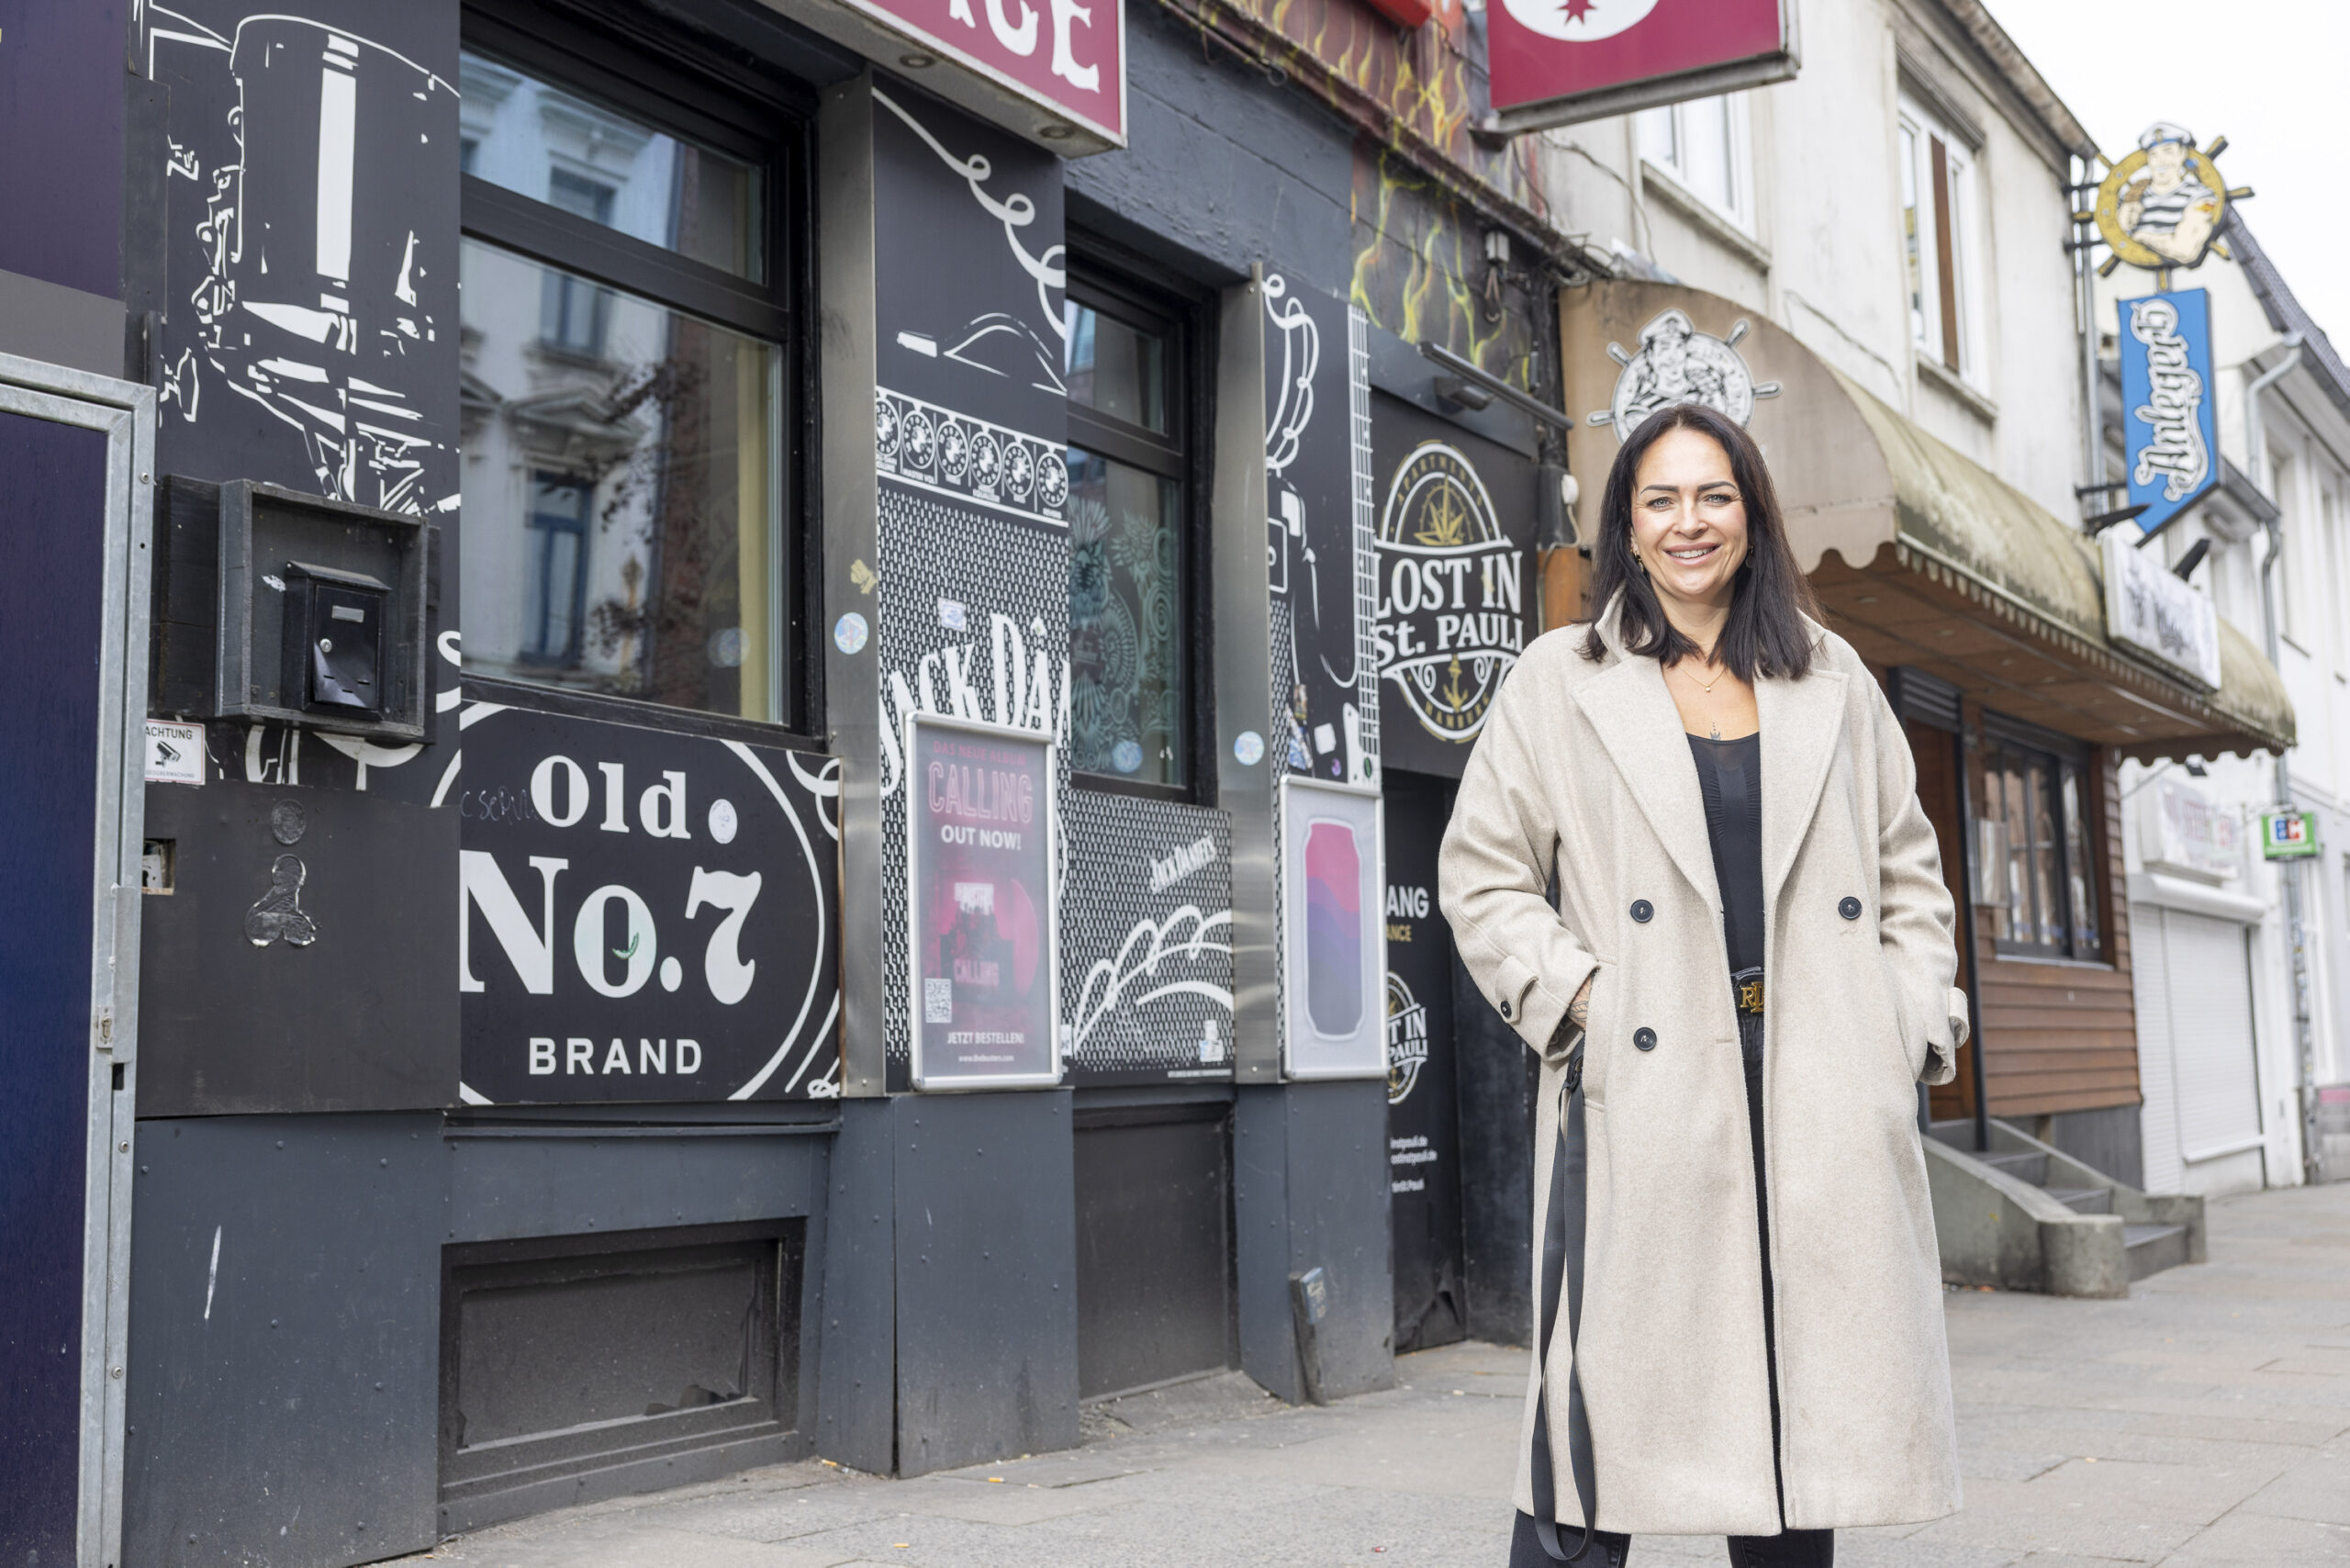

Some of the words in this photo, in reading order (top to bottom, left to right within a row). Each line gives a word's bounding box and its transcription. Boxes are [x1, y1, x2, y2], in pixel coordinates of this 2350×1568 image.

[1374, 552, 1472, 620] LOST
[1482, 552, 1523, 614] IN
[1373, 622, 1426, 668] St.
[1436, 611, 1524, 654] PAULI
[145, 726, 194, 740] ACHTUNG
[933, 741, 956, 756] DAS
[958, 745, 987, 761] NEUE
[990, 749, 1027, 767] ALBUM
[531, 755, 692, 839] Old
[928, 761, 1034, 823] CALLING
[941, 824, 976, 846] OUT
[979, 828, 1022, 851] NOW!
[946, 1031, 973, 1045] JETZT
[975, 1031, 1025, 1046] BESTELLEN!
[1404, 1008, 1427, 1040] IN
[529, 1036, 702, 1076] BRAND
